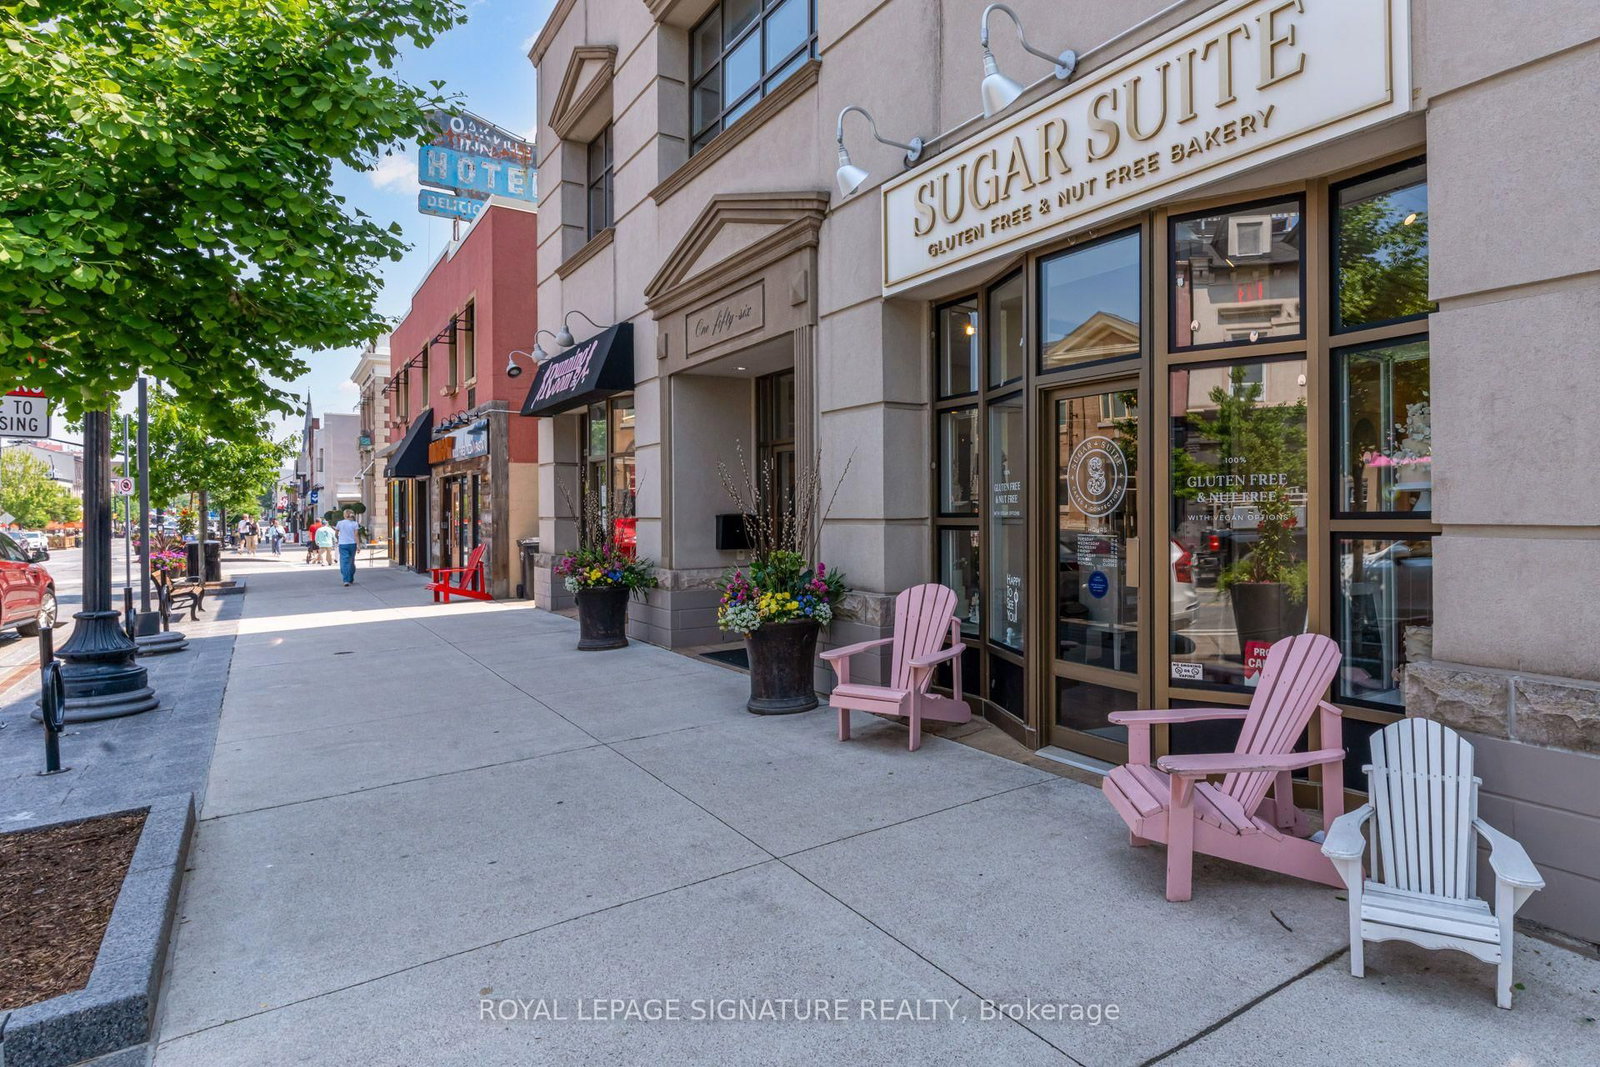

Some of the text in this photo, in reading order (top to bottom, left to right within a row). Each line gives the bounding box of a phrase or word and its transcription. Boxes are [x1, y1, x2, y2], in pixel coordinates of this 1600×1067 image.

[914, 0, 1306, 237] SUGAR SUITE
[927, 104, 1276, 257] GLUTEN FREE & NUT FREE BAKERY
[696, 317, 709, 338] One
[14, 400, 32, 415] TO
[0, 416, 38, 431] SING
[1072, 441, 1123, 470] SUGAR SUITE
[1010, 481, 1021, 491] FREE
[1187, 473, 1288, 488] GLUTEN FREE
[1197, 491, 1278, 503] & NUT FREE
[1006, 573, 1021, 587] HAPPY
